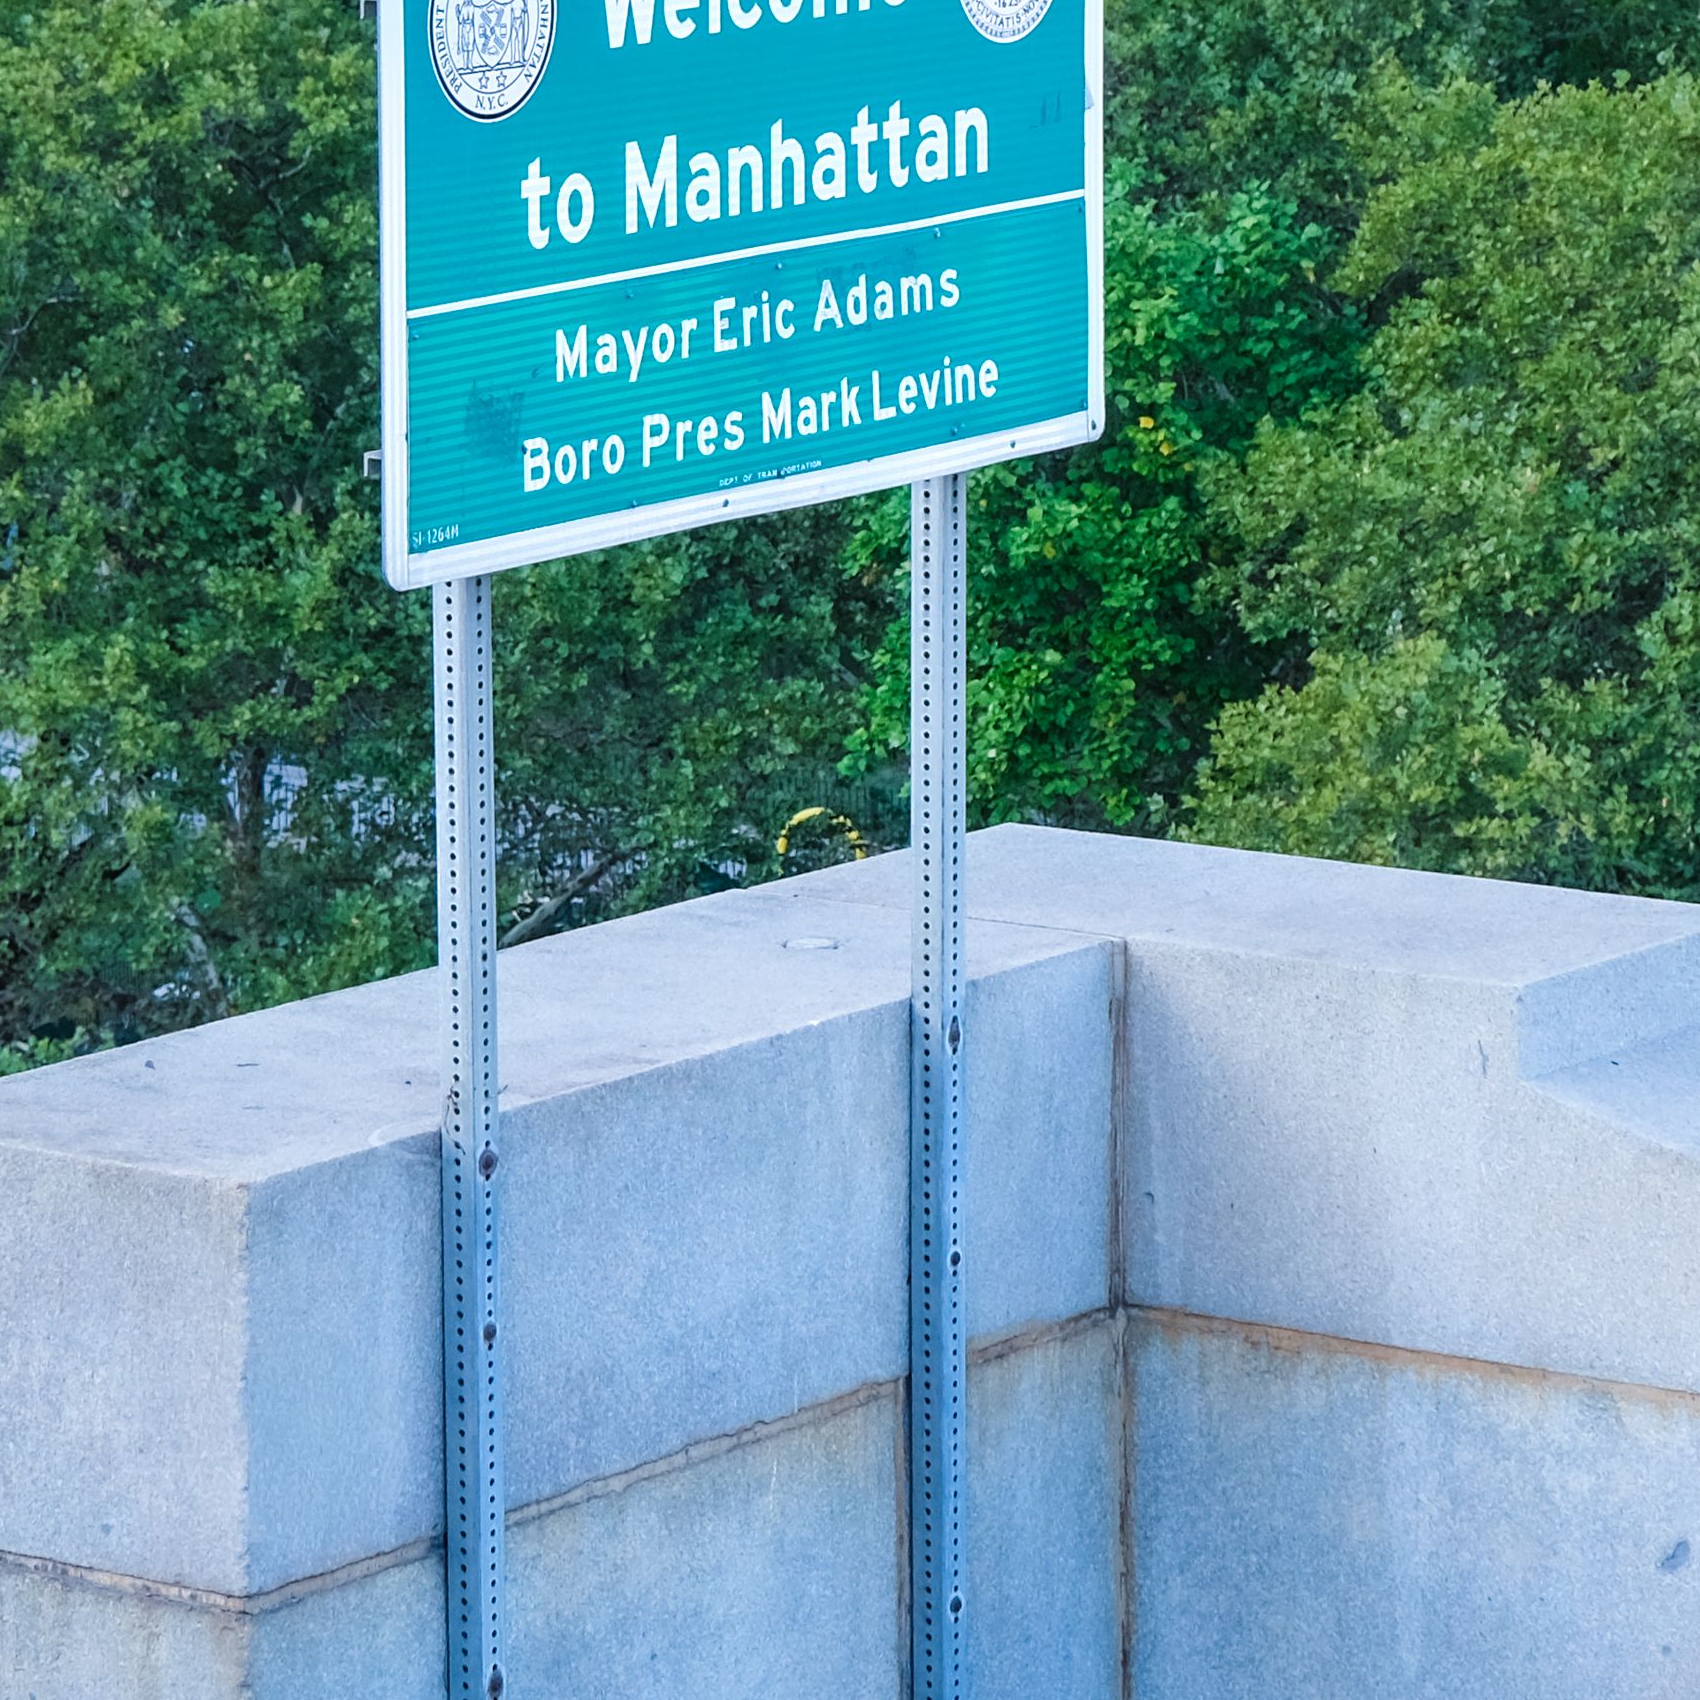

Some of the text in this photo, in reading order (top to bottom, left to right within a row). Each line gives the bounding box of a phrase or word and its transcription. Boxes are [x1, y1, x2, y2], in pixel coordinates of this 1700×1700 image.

[435, 5, 462, 94] PRESIDENT
[475, 94, 508, 111] N.Y.C.
[521, 101, 990, 250] to Manhattan
[556, 268, 960, 383] Mayor Eric Adams
[524, 355, 999, 493] Boro Pres Mark Levine
[719, 459, 822, 487] DEPT OF TRANPORTATION
